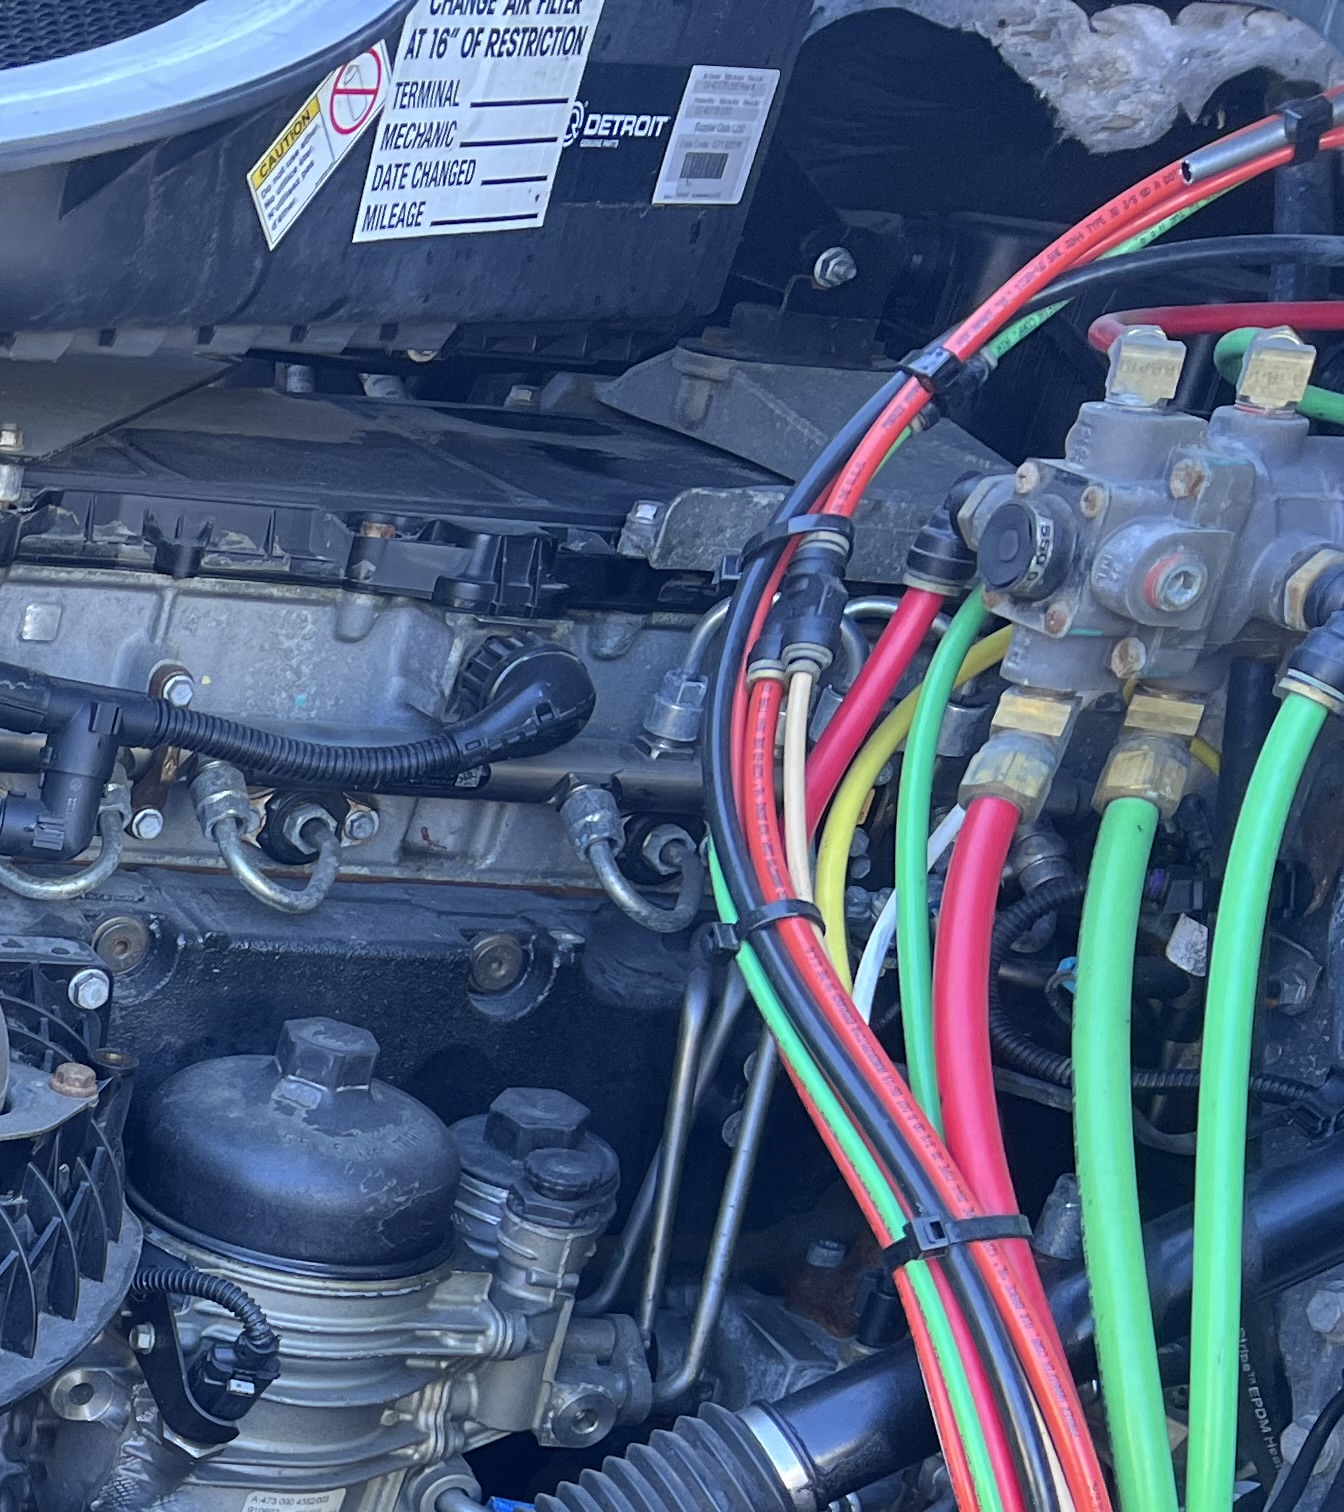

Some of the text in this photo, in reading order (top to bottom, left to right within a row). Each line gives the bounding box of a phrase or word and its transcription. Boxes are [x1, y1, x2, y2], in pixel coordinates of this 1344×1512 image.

[404, 28, 427, 60] AT
[461, 27, 483, 58] OF
[484, 25, 588, 59] RESTRICTION
[393, 79, 460, 110] TERMINAL
[380, 120, 458, 152] MECHANIC
[583, 114, 671, 137] DETROIT
[259, 110, 312, 179] CAUTION
[371, 159, 476, 192] DATE CHANGED
[362, 201, 426, 232] MILEAGE
[1248, 1386, 1272, 1433] EPDM
